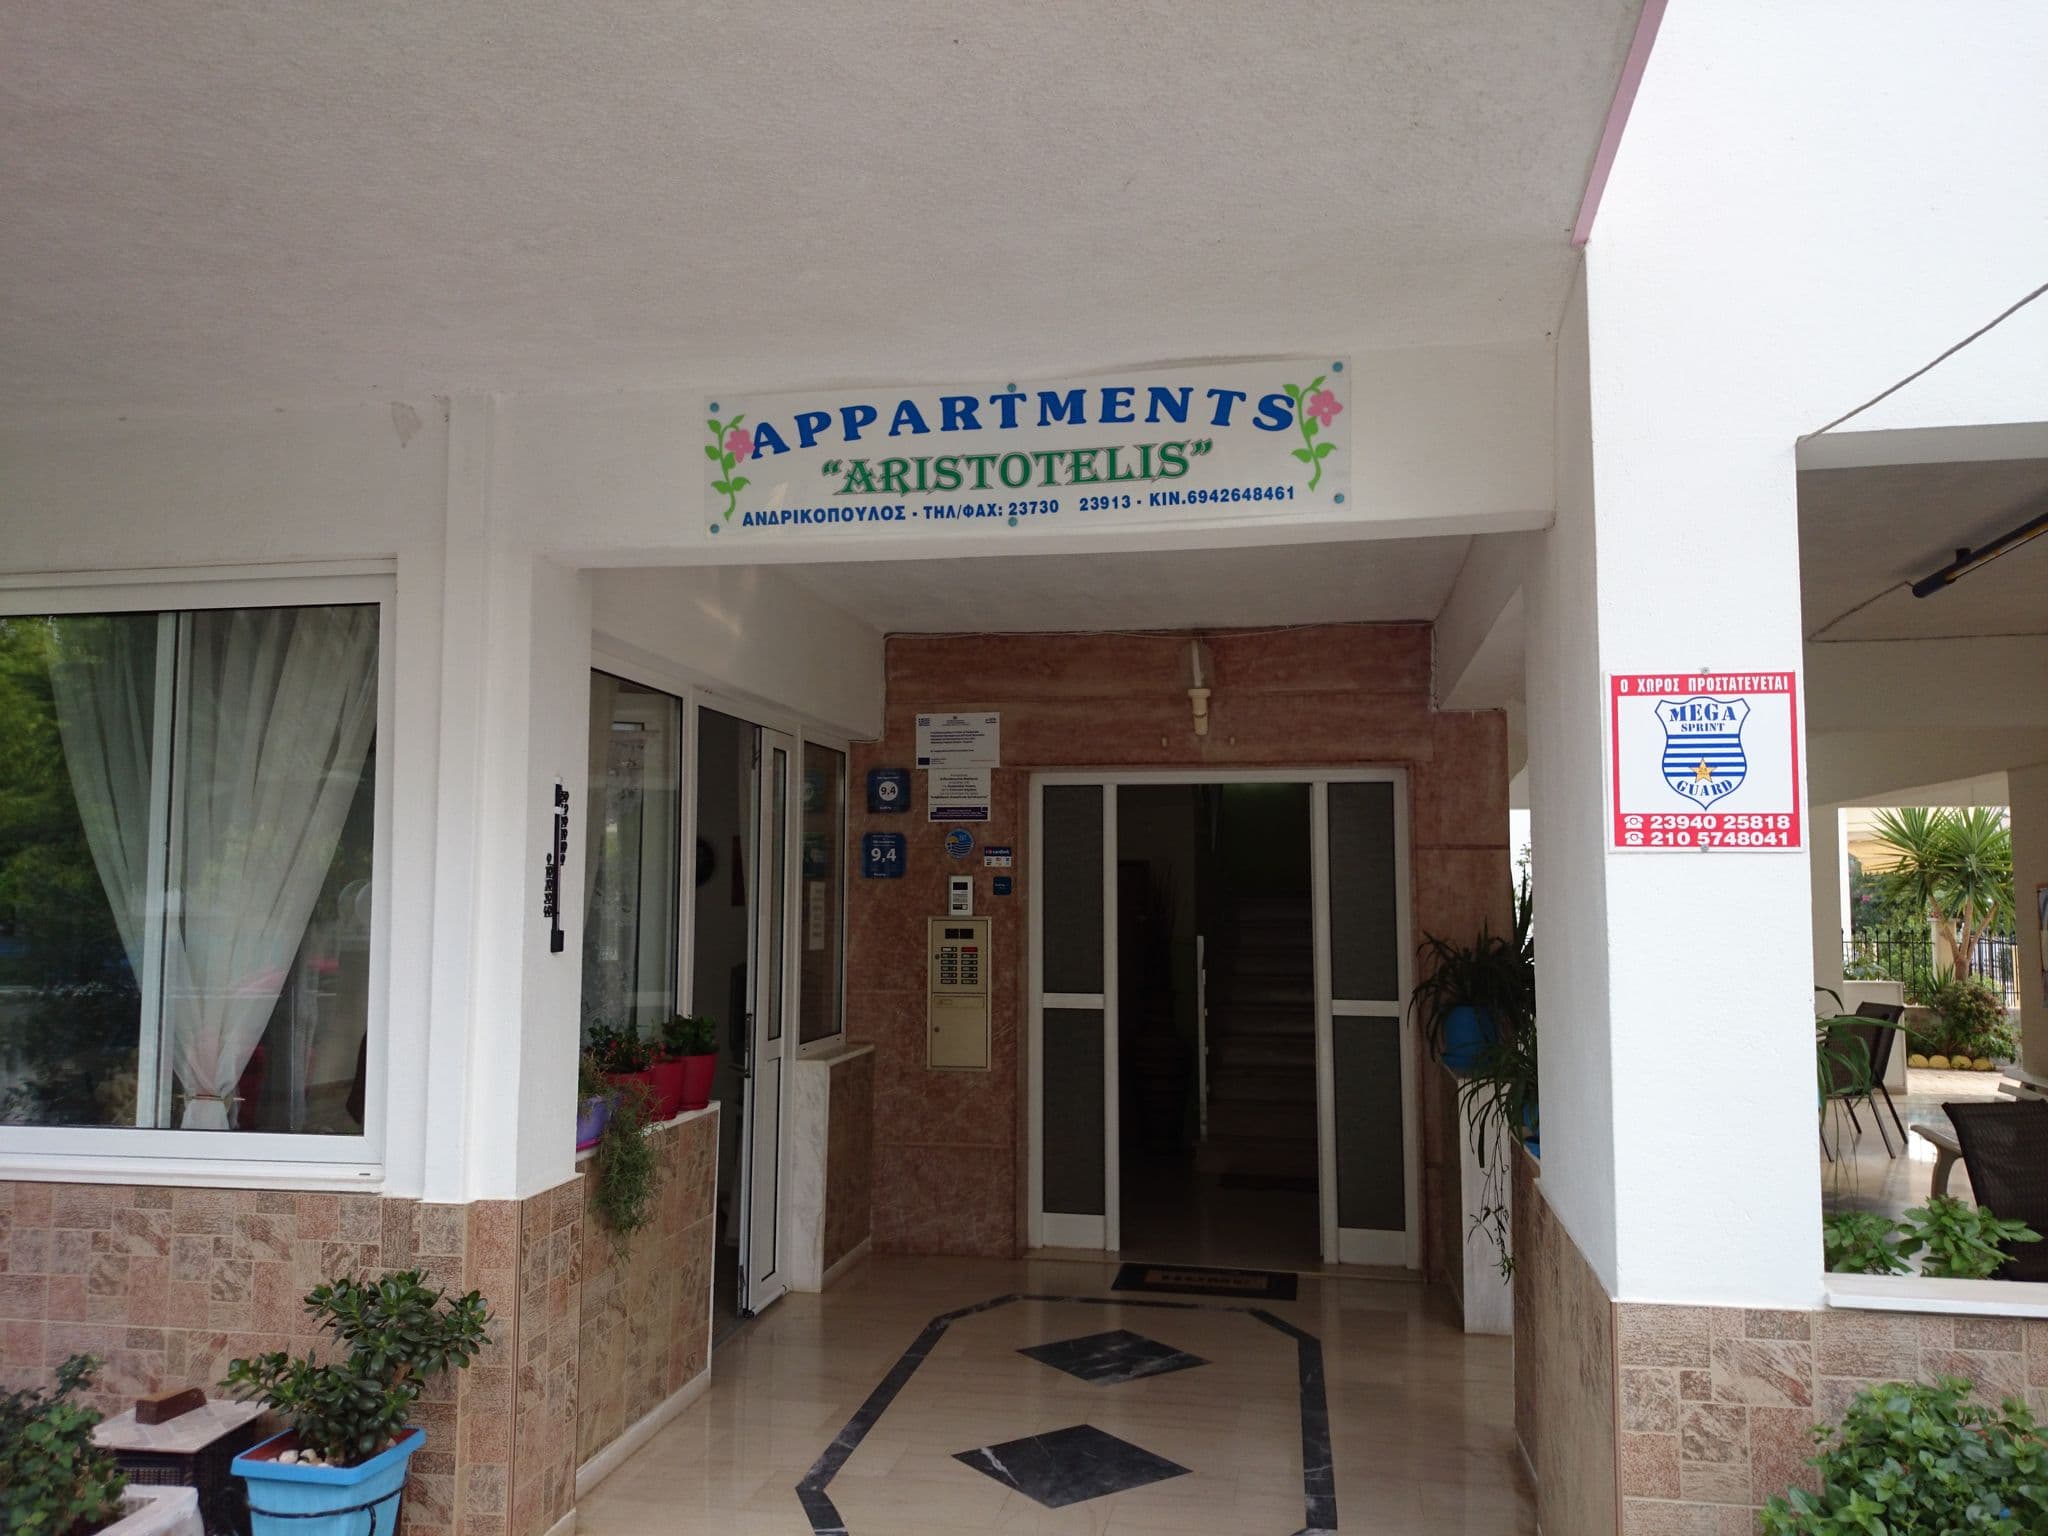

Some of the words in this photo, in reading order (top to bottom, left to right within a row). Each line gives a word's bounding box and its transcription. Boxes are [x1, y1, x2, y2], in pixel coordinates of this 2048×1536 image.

[752, 386, 1297, 459] APPARTMENTS
[821, 438, 1214, 497] “ARISTOTELIS”
[742, 505, 906, 527] ΑΝΔΡΙΚΟΠΟΥΛΟΣ
[923, 501, 1003, 520] ΤΗΛ/ΦΑΧ:
[1008, 499, 1060, 516] 23730
[1079, 494, 1132, 511] 23913
[1620, 678, 1629, 693] Ο
[1637, 677, 1680, 692] ΧΩΡΟΣ
[1688, 675, 1789, 692] ΠΡΟΣΤΑΤΕΥΕΤΑΙ
[1669, 703, 1737, 722] MEGA
[1680, 722, 1726, 733] SPRINT
[880, 786, 897, 797] 9,4
[1676, 779, 1733, 797] GUARD
[1650, 815, 1717, 830] 23940
[1723, 815, 1791, 830] 25818
[1650, 831, 1691, 846] 210
[1697, 831, 1789, 846] 5748041
[871, 847, 897, 863] 9,4
